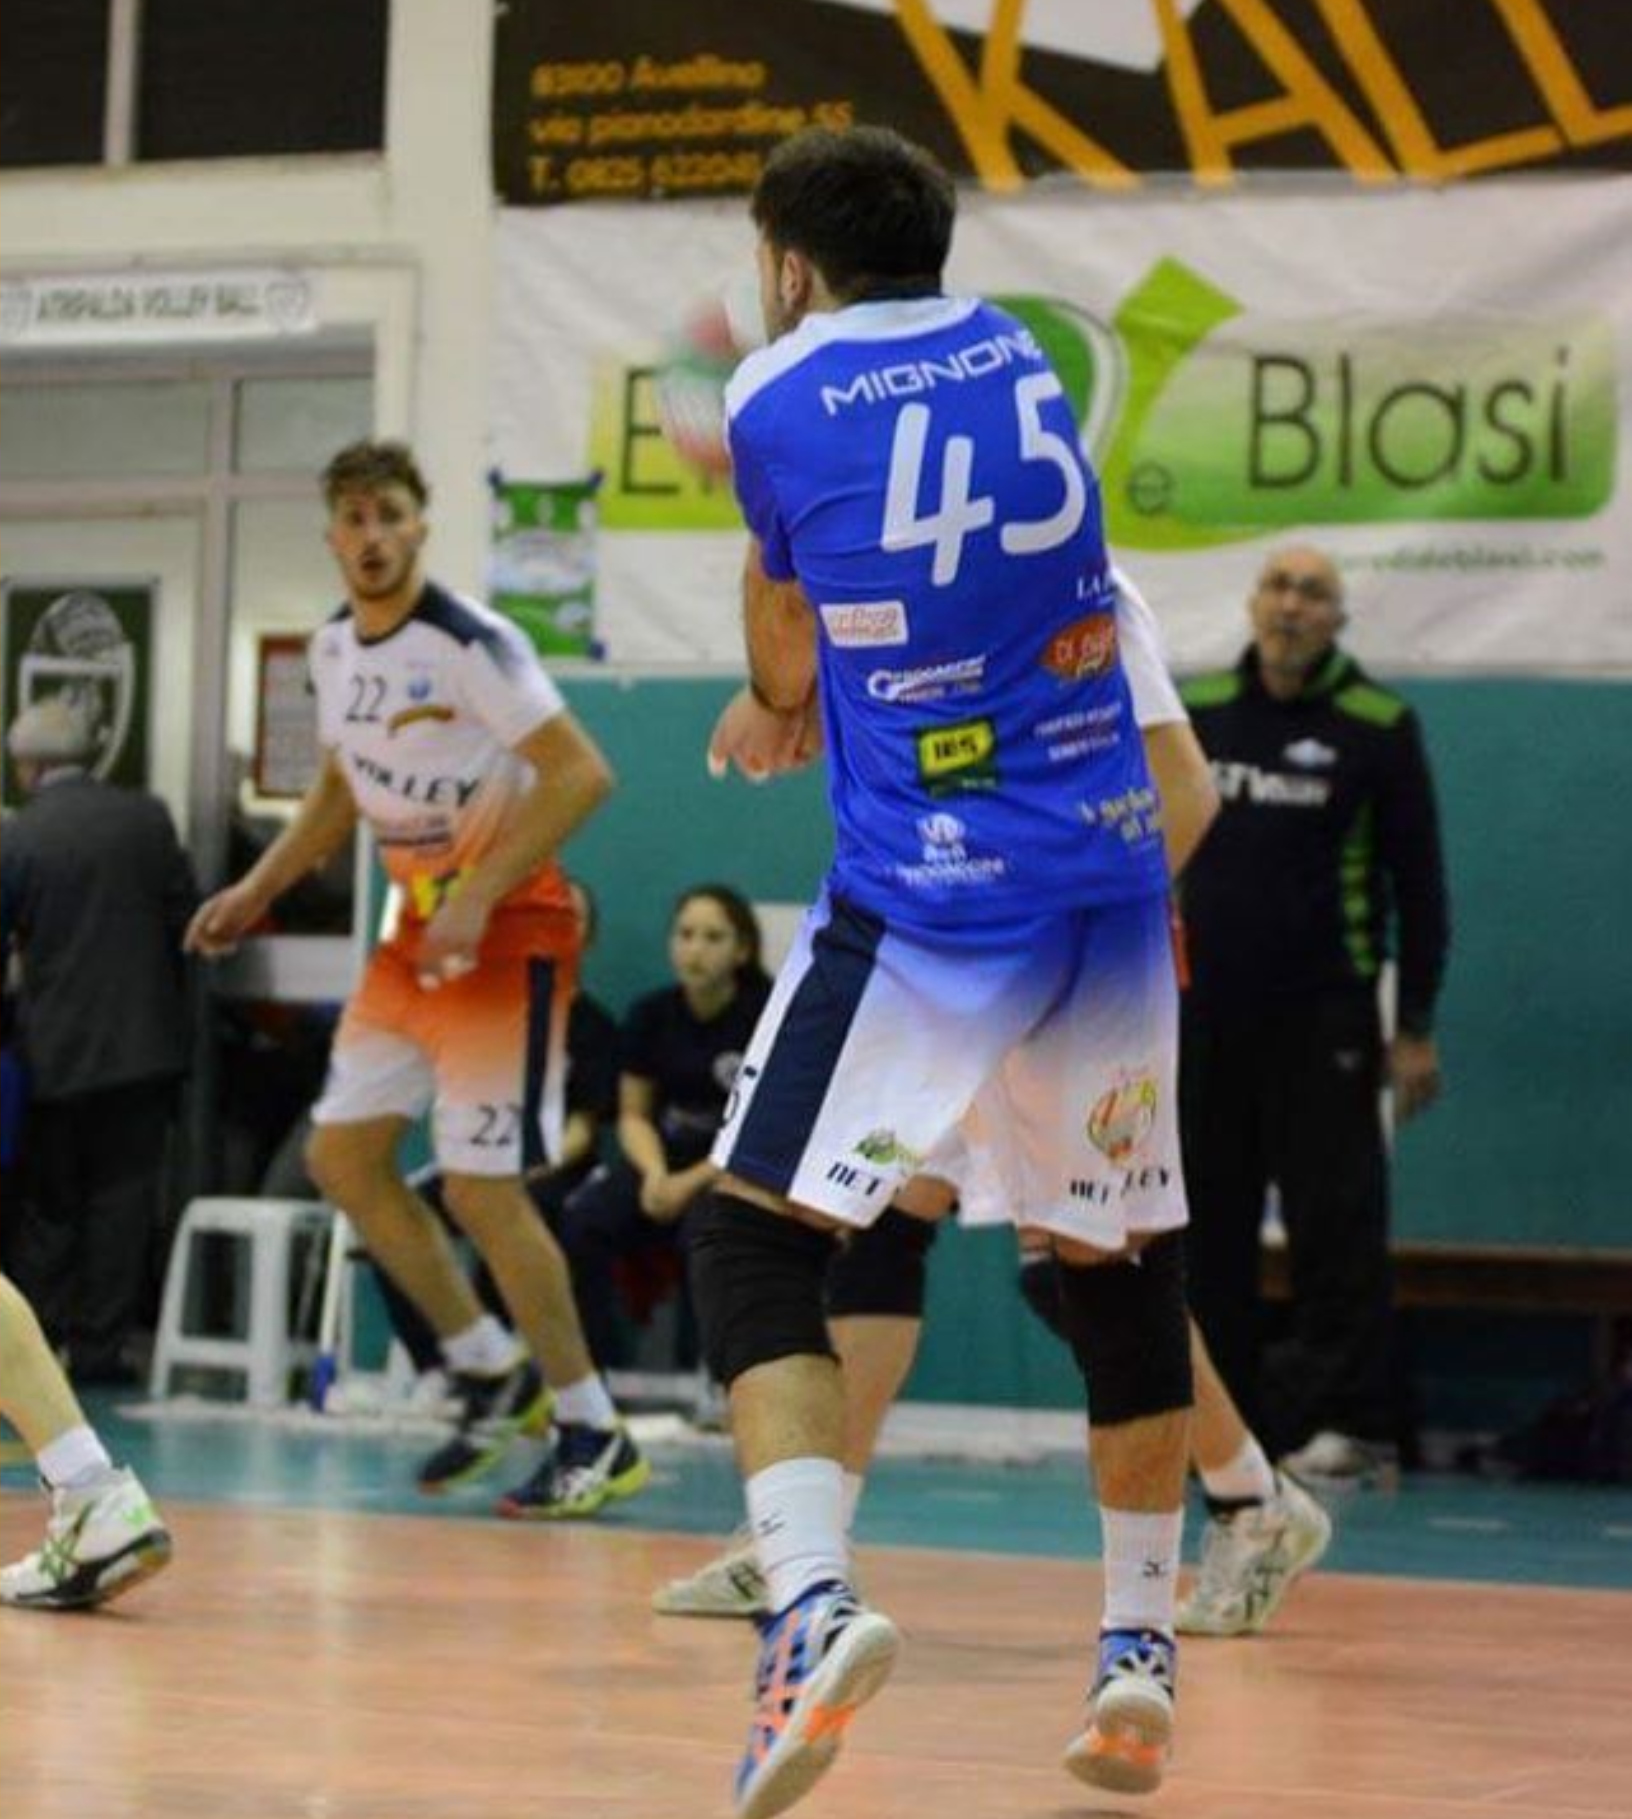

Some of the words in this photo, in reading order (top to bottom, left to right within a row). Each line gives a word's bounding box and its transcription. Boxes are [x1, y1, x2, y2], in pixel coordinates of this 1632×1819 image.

[631, 54, 765, 90] Avellino
[1246, 346, 1570, 492] Blasi
[881, 371, 1087, 586] 45
[344, 674, 388, 722] 22
[469, 1101, 521, 1147] 22
